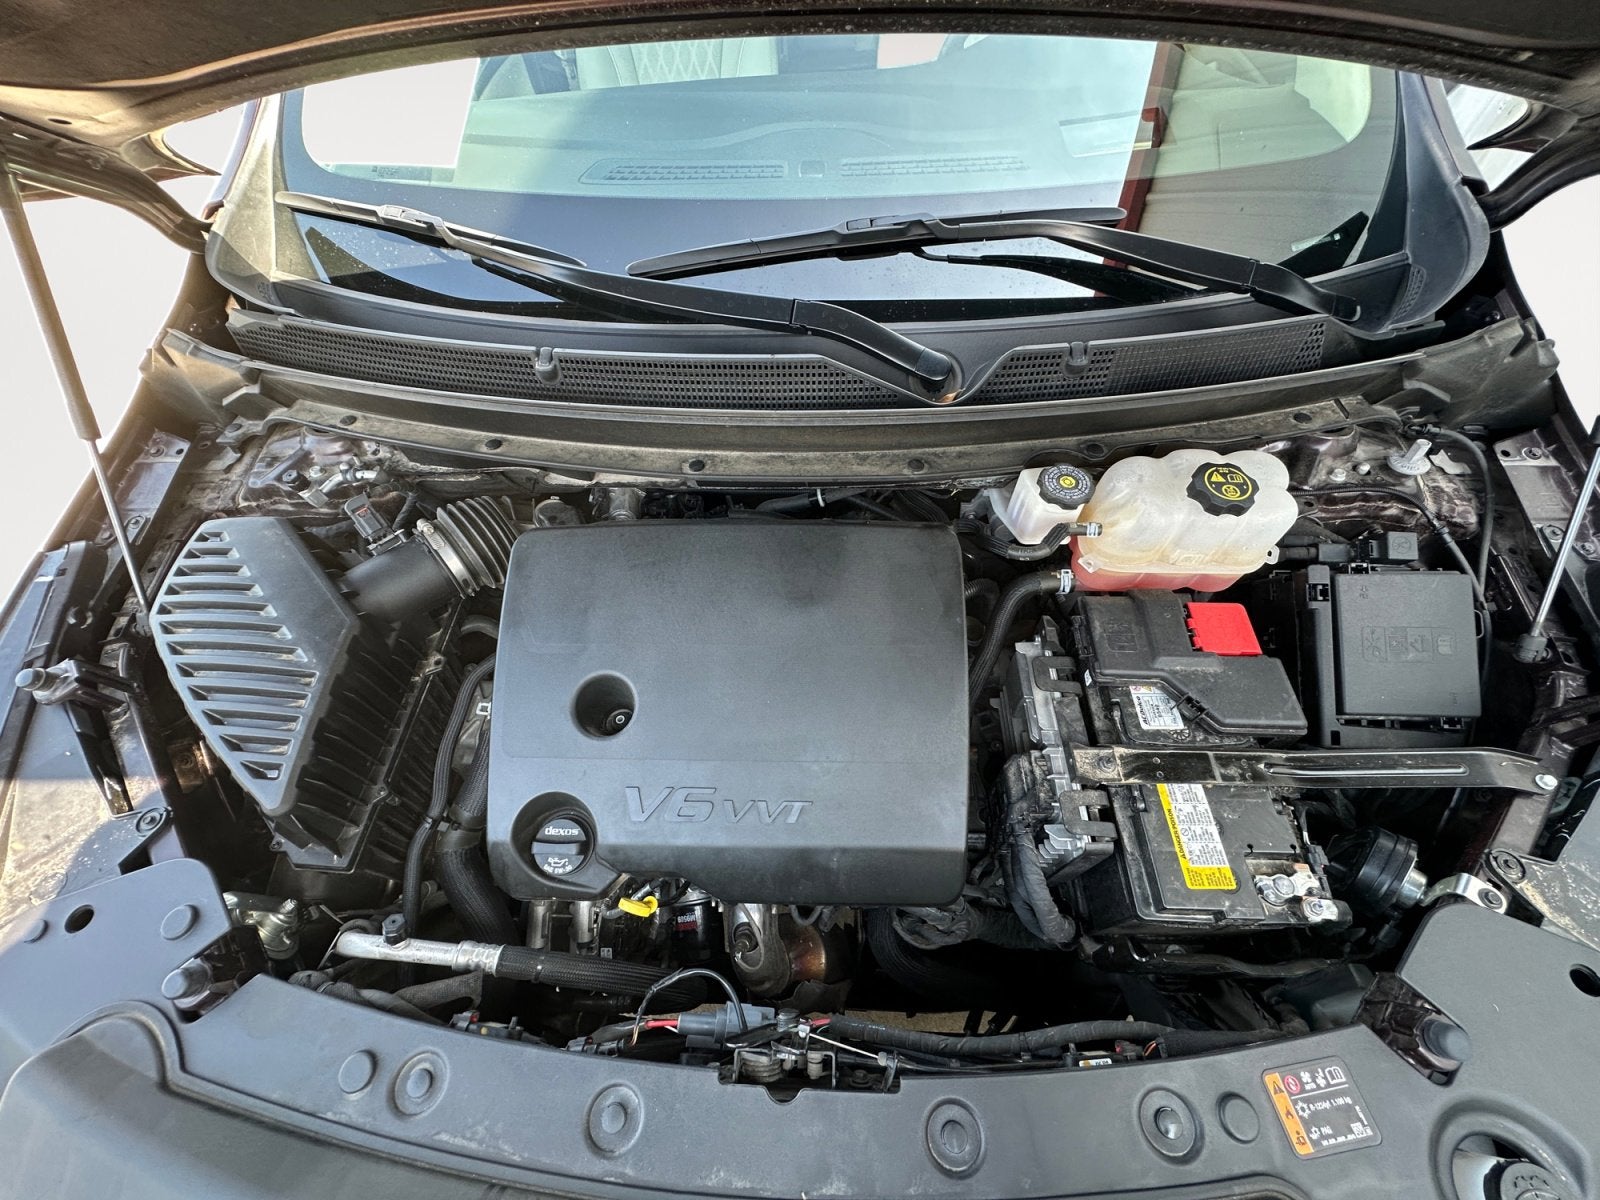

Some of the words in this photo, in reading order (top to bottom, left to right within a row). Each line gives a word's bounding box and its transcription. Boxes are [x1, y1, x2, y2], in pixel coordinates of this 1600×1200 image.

[625, 786, 716, 824] V6
[722, 799, 813, 824] VVT
[544, 826, 580, 836] dexos
